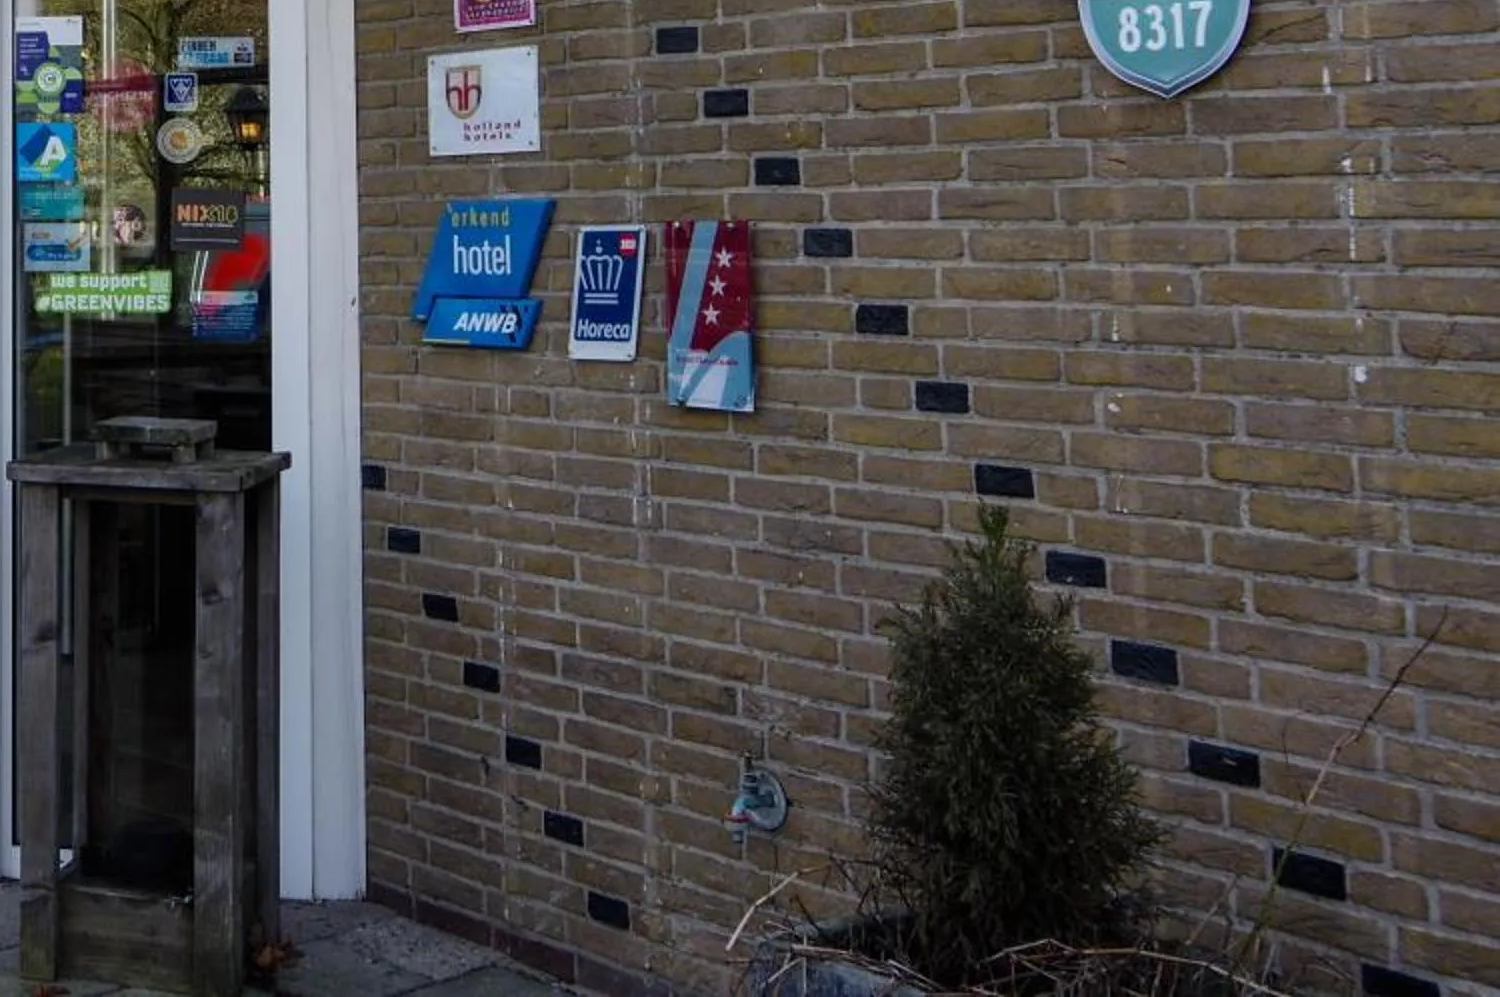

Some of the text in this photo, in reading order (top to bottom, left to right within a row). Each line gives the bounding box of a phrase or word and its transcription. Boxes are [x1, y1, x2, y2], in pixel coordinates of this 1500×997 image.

[1118, 0, 1213, 53] 8317
[463, 118, 521, 131] holland
[463, 131, 512, 142] hotels
[451, 205, 510, 228] erkend
[453, 234, 512, 276] hotel
[50, 274, 76, 289] we
[79, 274, 148, 292] support
[452, 310, 519, 334] ANWB
[577, 318, 631, 340] Horeca
